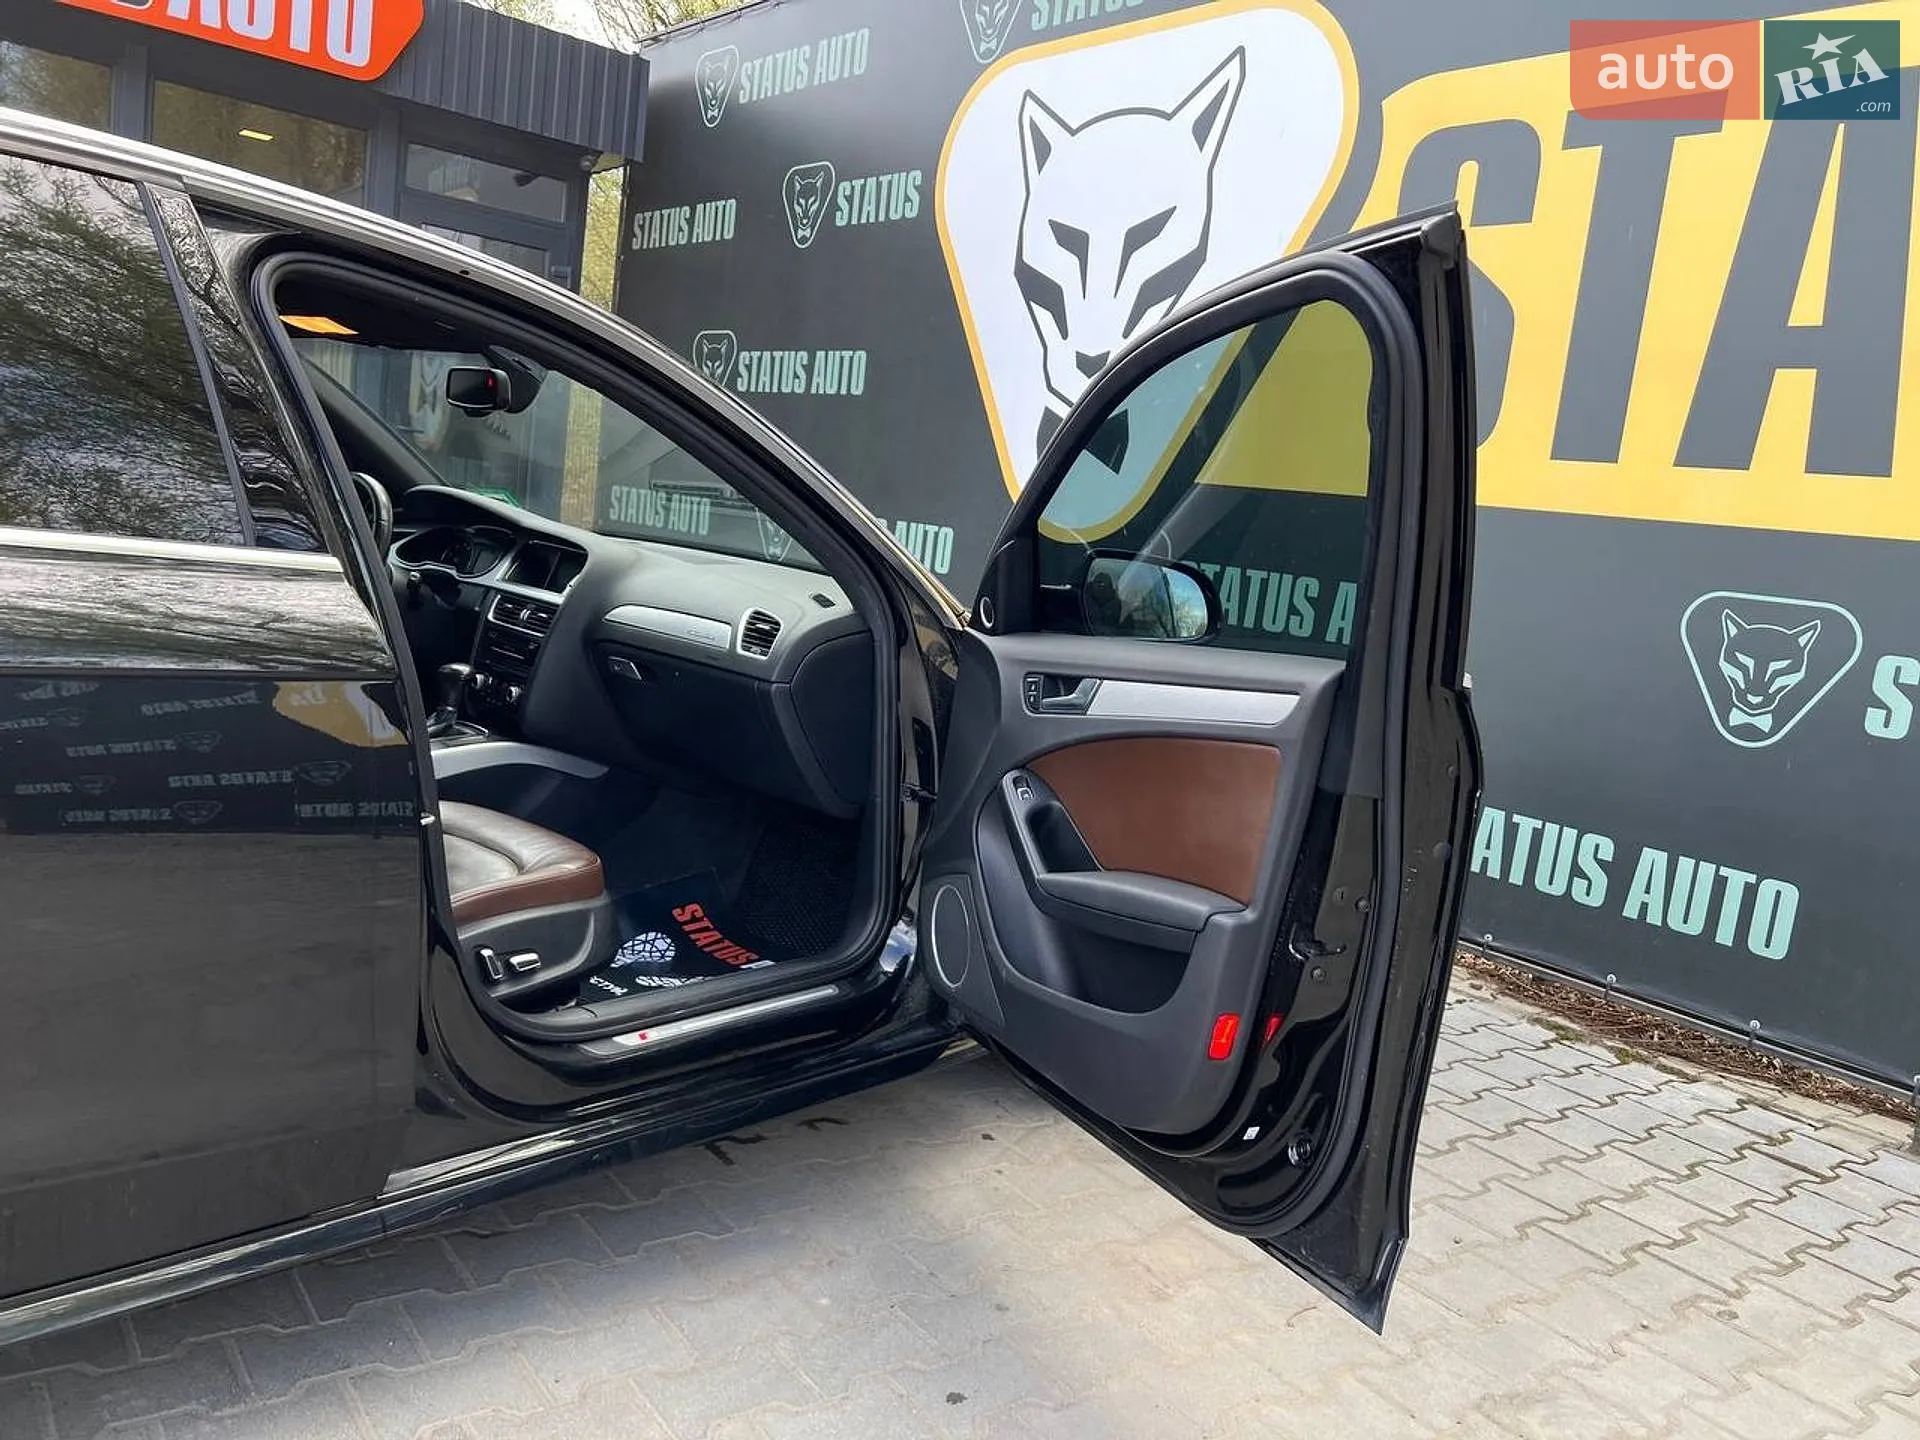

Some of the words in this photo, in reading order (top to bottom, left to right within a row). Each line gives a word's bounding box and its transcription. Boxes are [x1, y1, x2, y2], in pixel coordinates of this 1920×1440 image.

[166, 0, 373, 67] TO
[1031, 0, 1144, 31] STA
[739, 44, 810, 104] STATUS
[813, 28, 870, 86] AUTO
[632, 206, 691, 250] STATUS
[692, 198, 737, 243] AUTO
[835, 170, 922, 226] STATUS
[737, 350, 808, 393] STATUS
[810, 350, 867, 395] AUTO
[609, 485, 666, 528] STATUS
[668, 493, 711, 535] AUTO
[1183, 560, 1320, 637] ATUS
[1622, 847, 1800, 960] AUTO
[672, 903, 760, 965] STATUS
